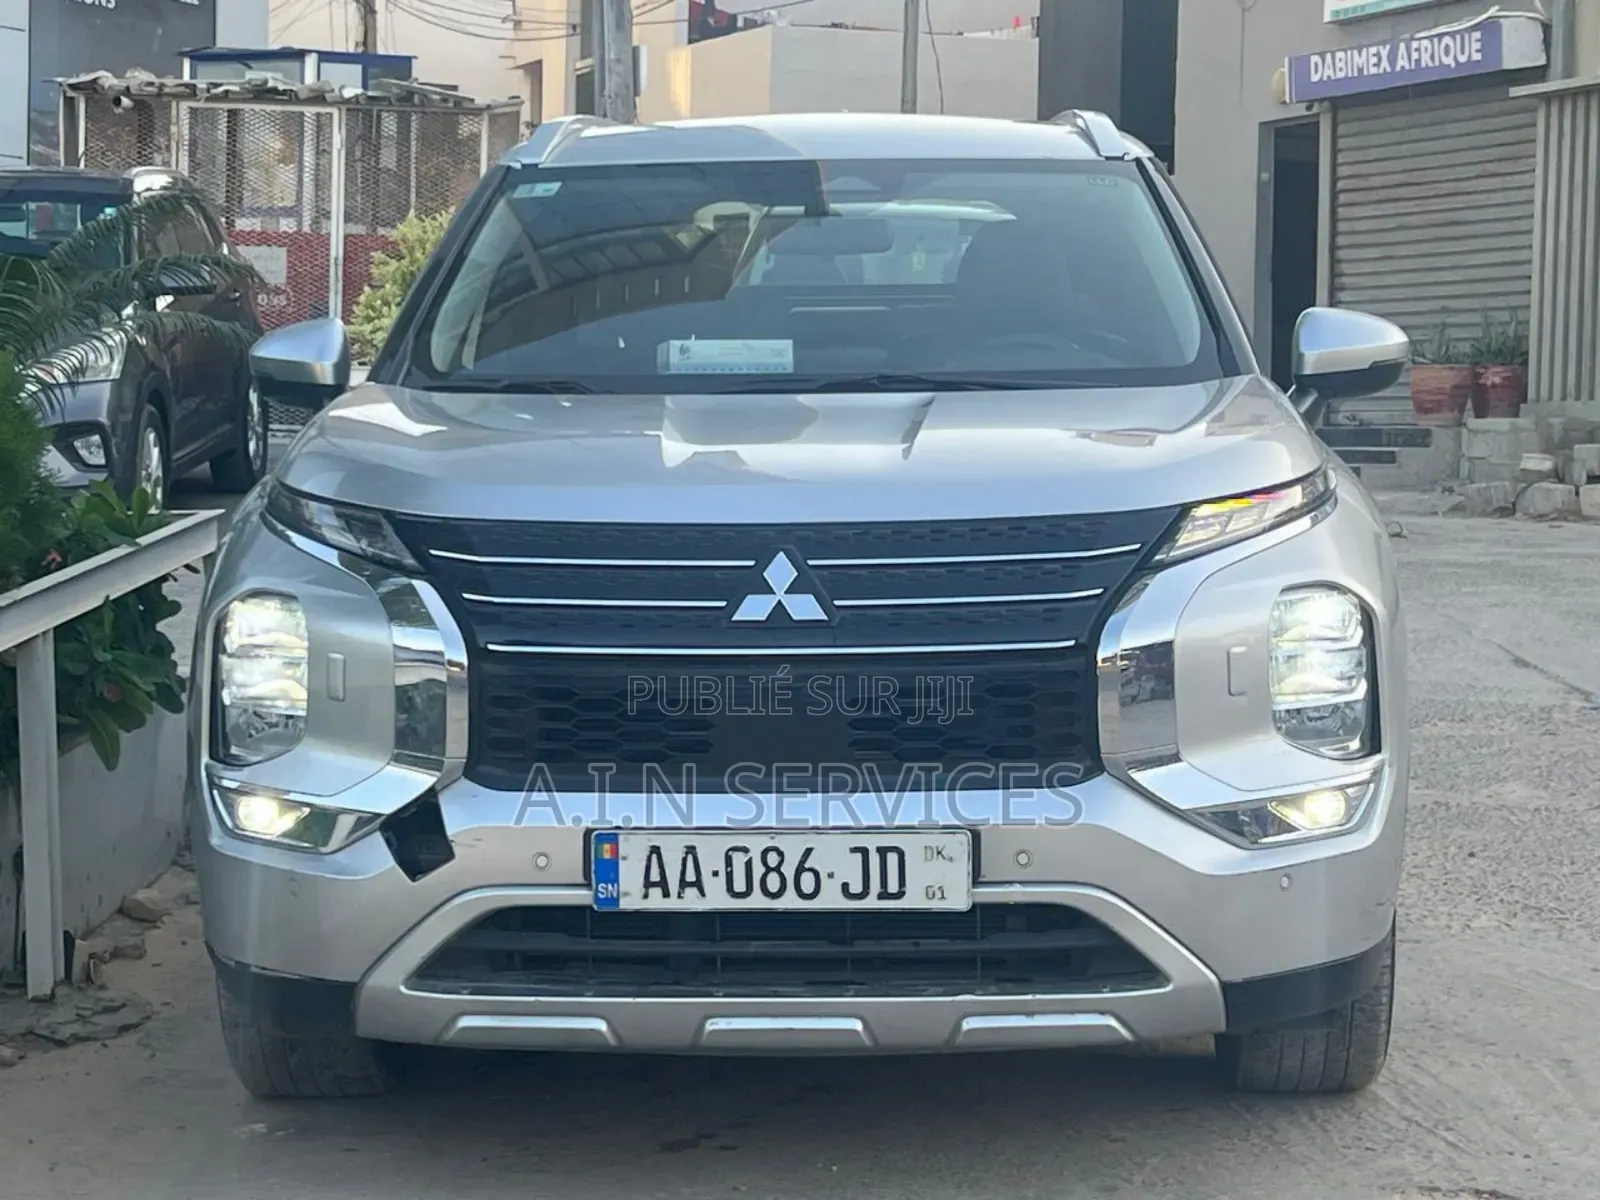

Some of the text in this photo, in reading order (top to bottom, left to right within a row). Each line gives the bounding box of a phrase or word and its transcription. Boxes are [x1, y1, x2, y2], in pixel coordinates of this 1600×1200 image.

[1310, 31, 1482, 82] DABIMEX AFRIQUE
[598, 883, 618, 899] SN
